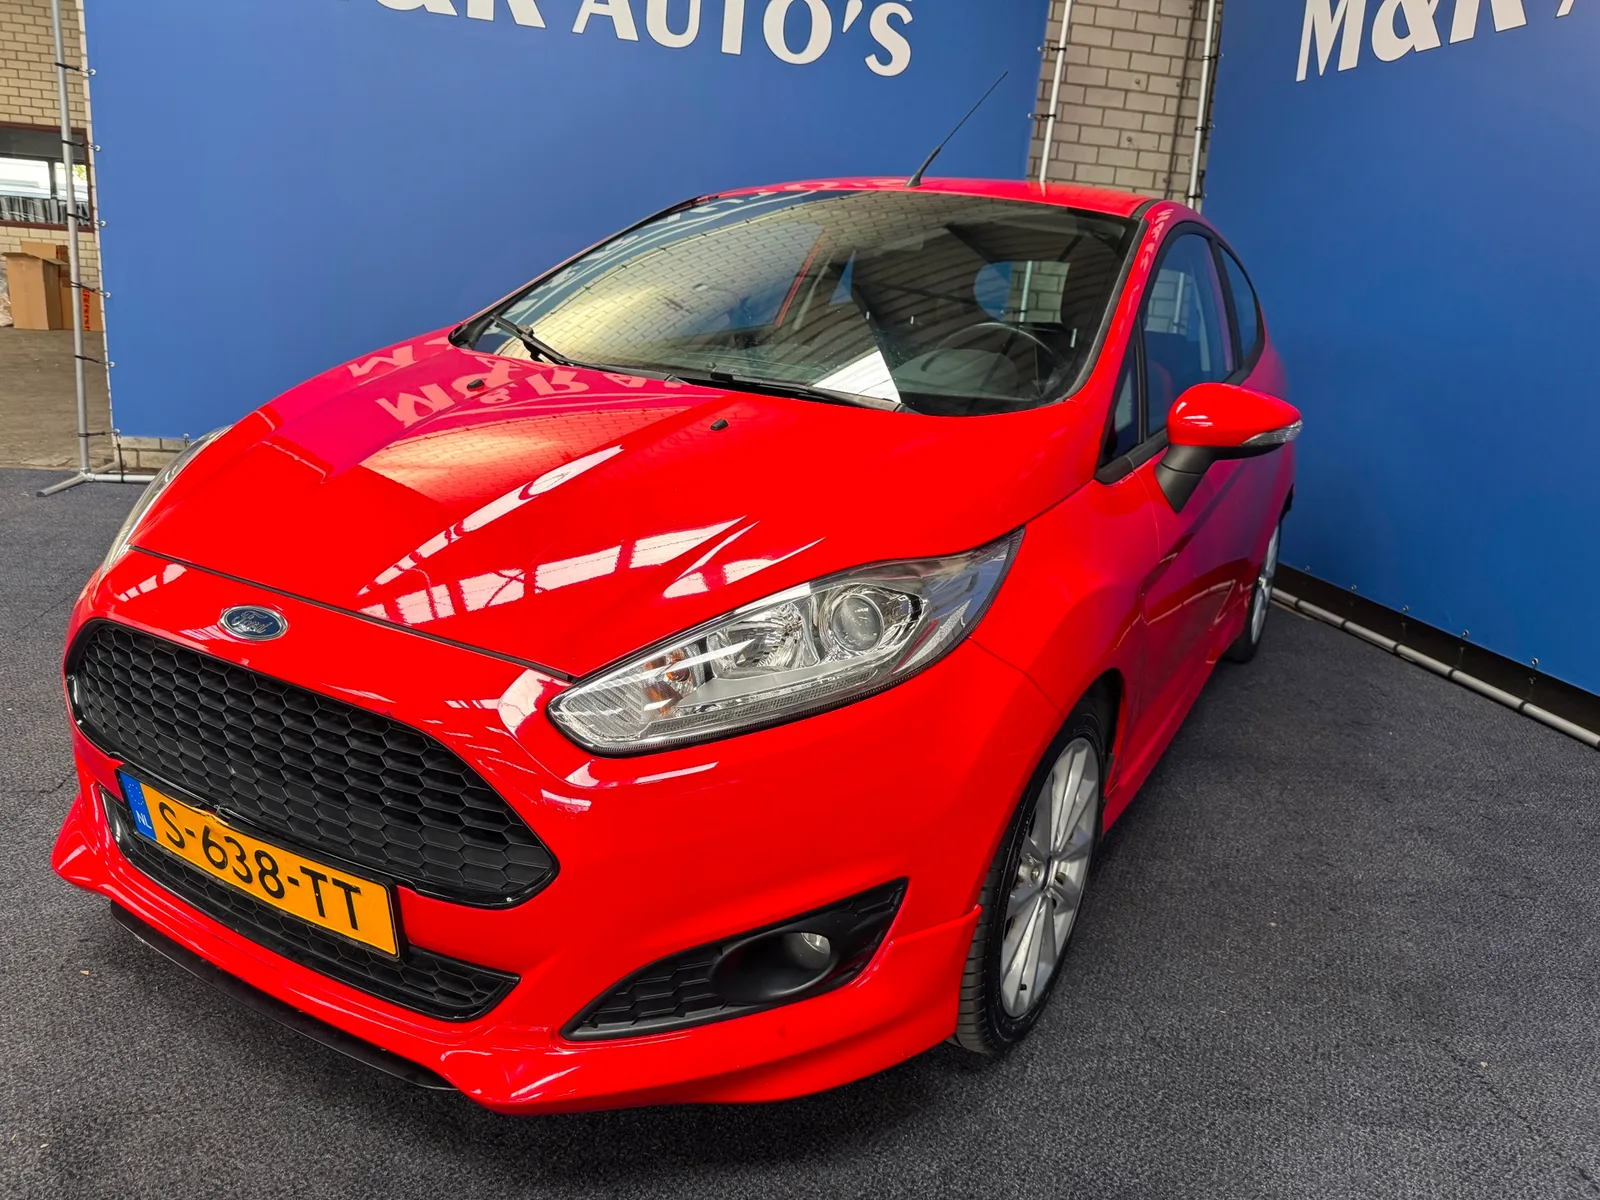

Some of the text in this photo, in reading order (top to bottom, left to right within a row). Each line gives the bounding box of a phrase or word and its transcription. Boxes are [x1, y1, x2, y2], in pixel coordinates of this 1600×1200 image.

[231, 610, 273, 634] Ford
[135, 809, 153, 830] NL
[158, 801, 361, 931] S-638-TT
